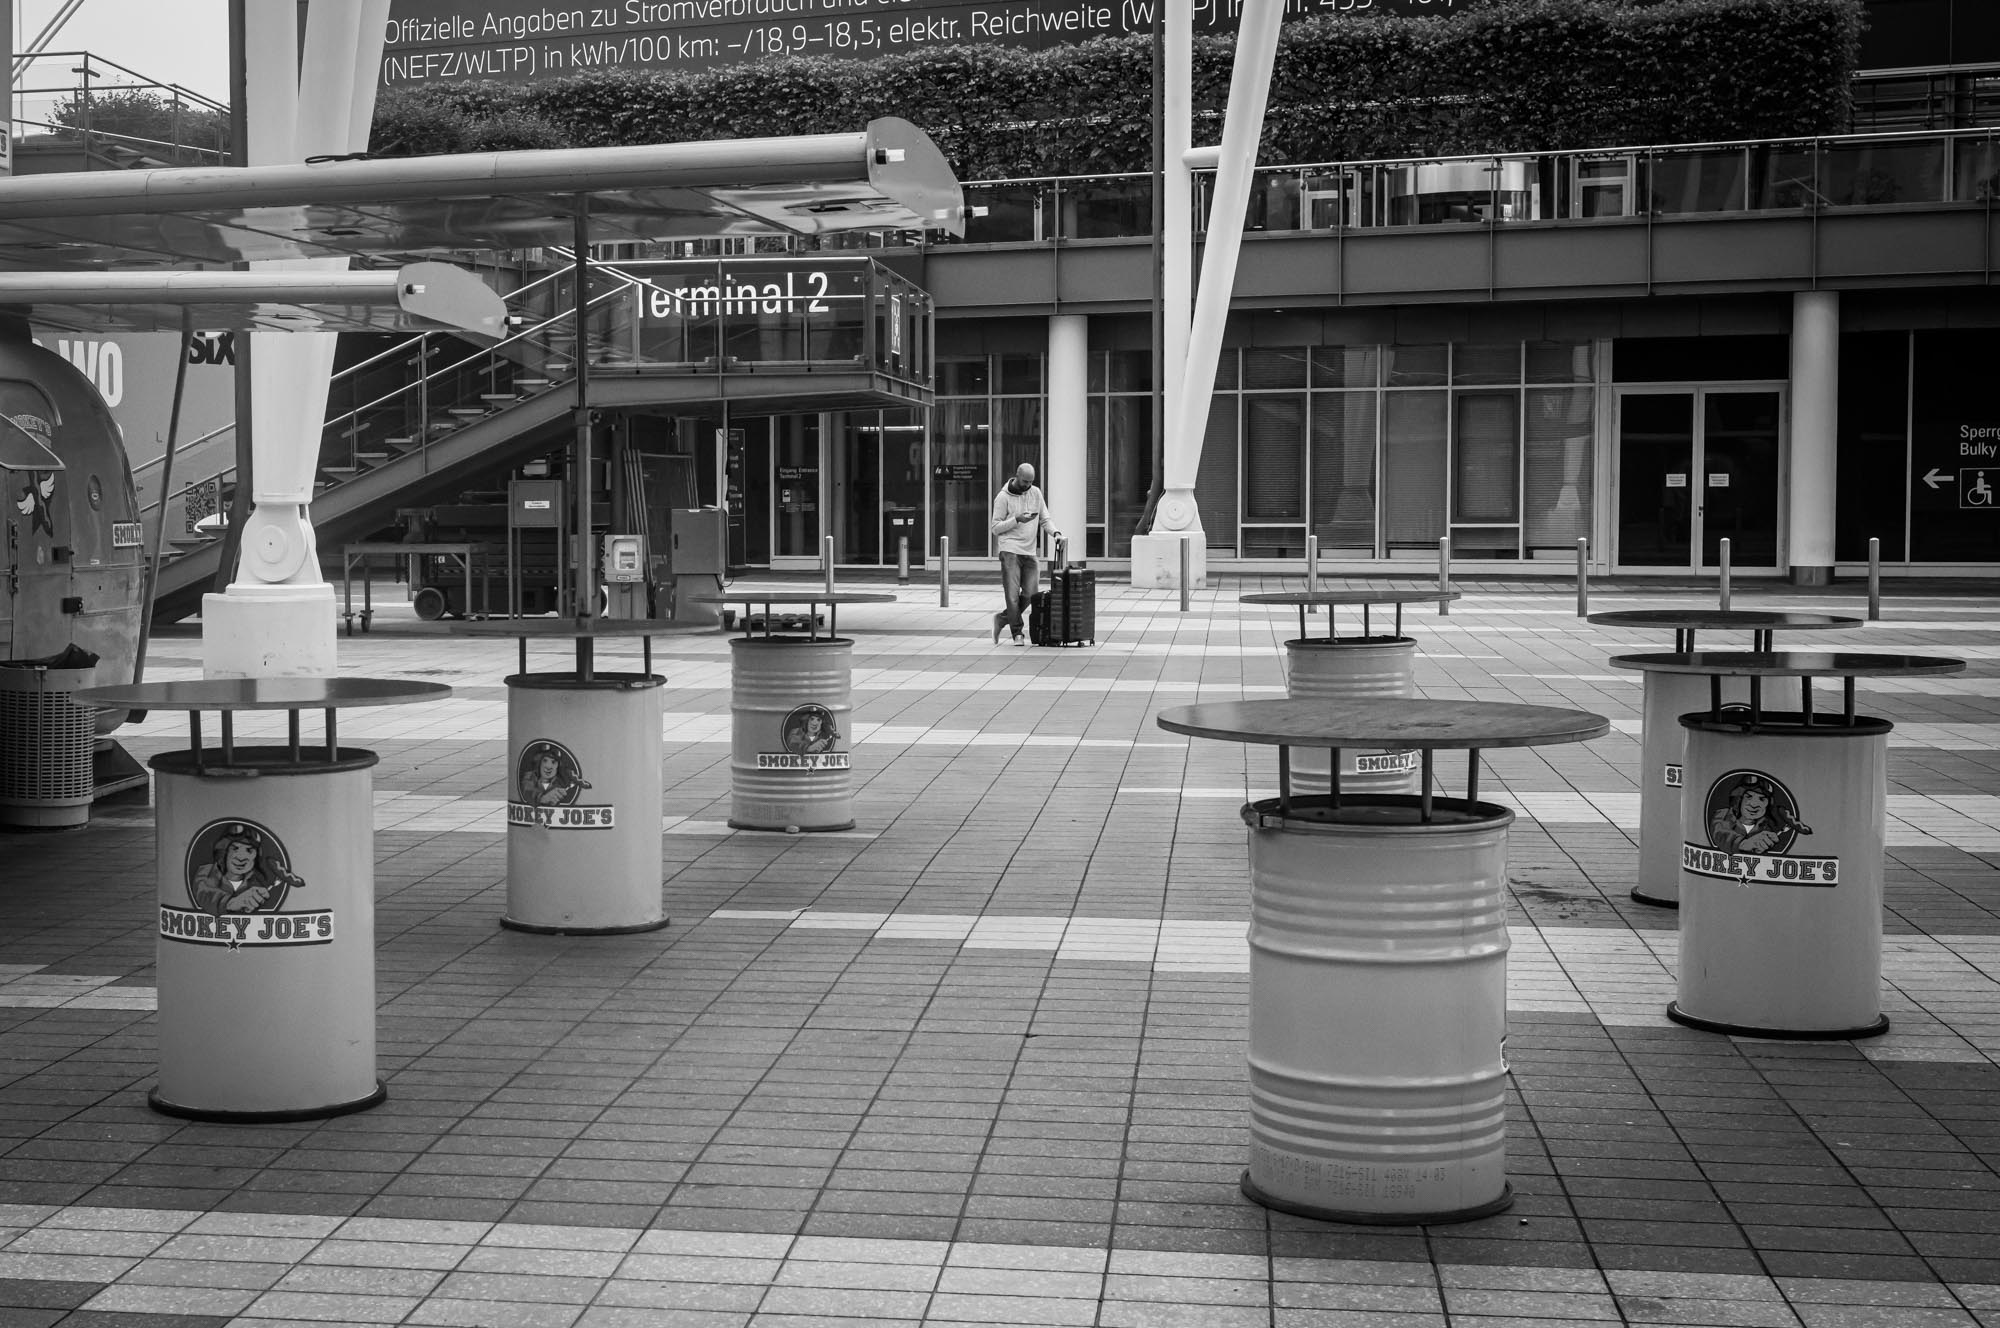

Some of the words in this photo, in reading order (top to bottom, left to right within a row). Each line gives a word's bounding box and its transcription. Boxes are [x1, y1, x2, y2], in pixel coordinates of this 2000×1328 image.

[384, 15, 475, 44] Offizielle
[481, 8, 584, 39] Angaben
[590, 8, 617, 28] zu
[384, 46, 535, 86] (NEFZ/WLTP)
[544, 45, 563, 69] in
[571, 35, 671, 66] kWh/100
[678, 35, 720, 59] km:
[889, 15, 962, 43] elektr.
[971, 3, 1111, 37] Reichweite
[636, 271, 794, 319] Terminal
[808, 271, 830, 314] 2
[1959, 442, 1998, 459] Bulky
[758, 755, 820, 768] SMOKEY
[1357, 754, 1410, 771] SMOKEY
[558, 808, 613, 826] JOE'S
[1683, 846, 1761, 877] SMOKEY
[1766, 858, 1837, 881] JOE'S
[160, 910, 251, 940] SMOKEY
[257, 914, 332, 940] JOE'S
